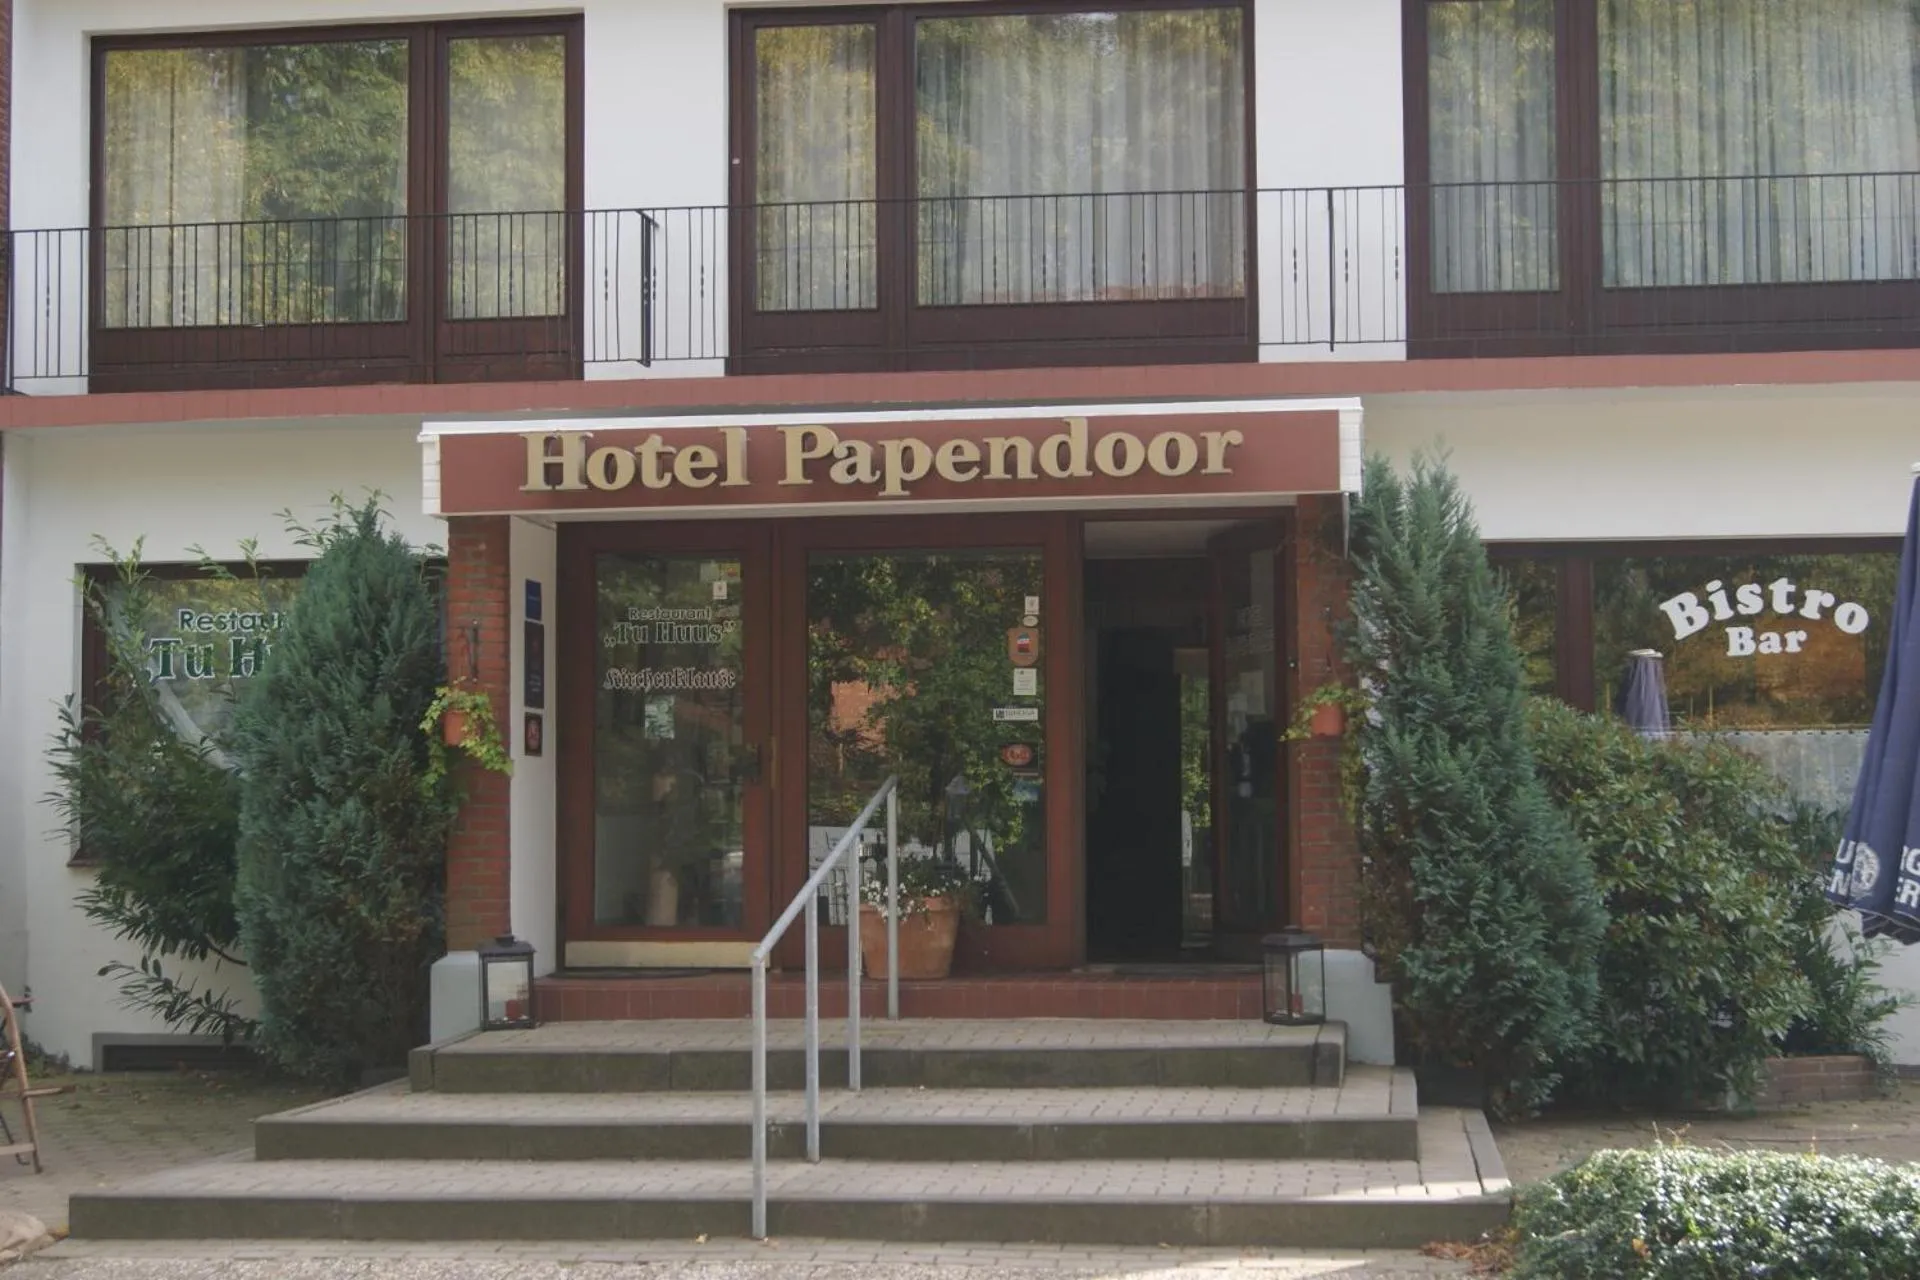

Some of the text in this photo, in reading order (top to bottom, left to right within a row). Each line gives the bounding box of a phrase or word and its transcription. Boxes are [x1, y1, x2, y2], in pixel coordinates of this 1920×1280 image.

[519, 417, 1244, 497] Hotel Papendoor
[628, 607, 712, 621] Restaurant
[1659, 577, 1869, 641] Bistro
[1725, 626, 1808, 657] Bar
